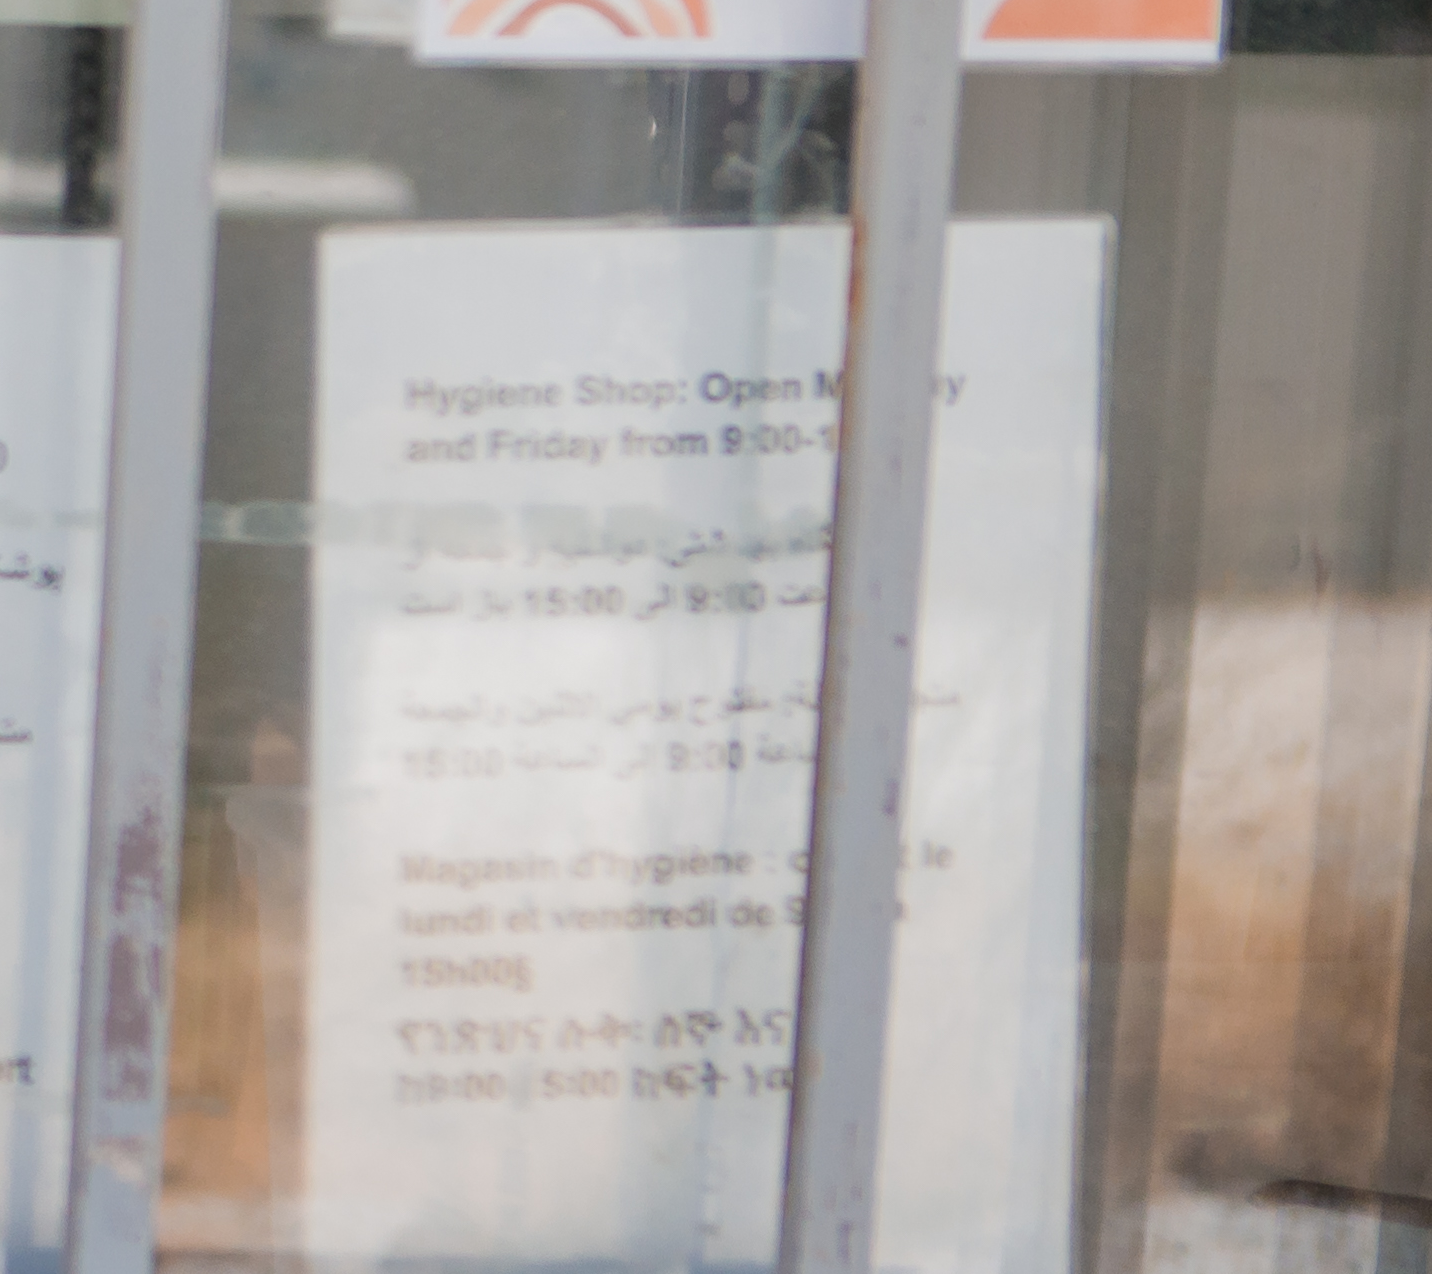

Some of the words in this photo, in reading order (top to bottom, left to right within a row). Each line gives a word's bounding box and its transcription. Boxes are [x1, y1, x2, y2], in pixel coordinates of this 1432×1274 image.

[405, 377, 561, 415] Hygiene
[574, 374, 688, 413] Shop:
[698, 370, 802, 411] Open
[405, 433, 477, 463] and
[488, 429, 605, 467] Friday
[619, 428, 707, 458] from
[522, 585, 626, 620] 15:00
[400, 851, 560, 890] Magasin
[570, 846, 754, 887] d'hygiène
[922, 840, 955, 871] le
[396, 904, 494, 937] lundi
[504, 903, 540, 933] et
[553, 897, 716, 932] vendredi
[728, 898, 776, 929] de
